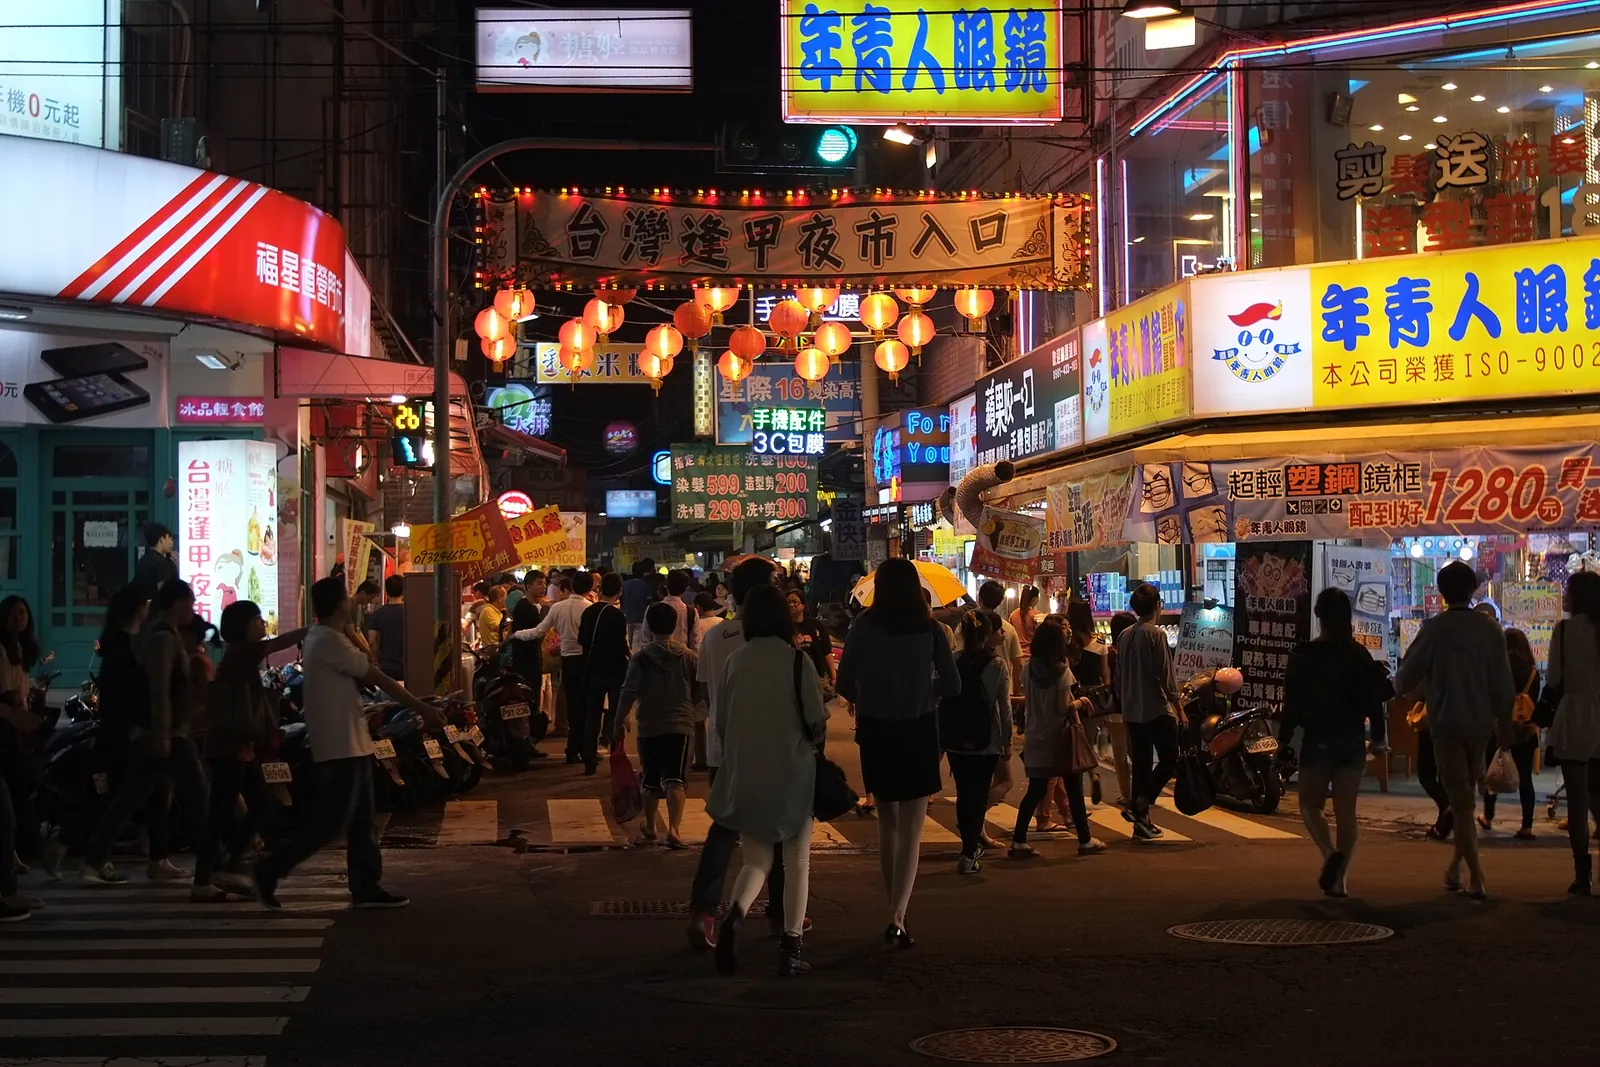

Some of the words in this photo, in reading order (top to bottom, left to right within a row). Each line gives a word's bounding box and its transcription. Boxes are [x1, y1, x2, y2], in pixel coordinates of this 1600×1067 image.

[799, 3, 1047, 94] 年青人眼鏡
[566, 202, 1009, 272] 台灣逢甲夜市入口
[179, 401, 264, 417] 冰品輕食館
[753, 409, 825, 431] 手機配件
[908, 412, 950, 434] For
[754, 432, 825, 454] 3C包膜
[908, 442, 951, 463] You
[1228, 462, 1422, 501] 超輕塑鋼鏡框
[1424, 464, 1545, 524] 1280
[1348, 499, 1423, 528] 配到好
[1250, 520, 1307, 535] 年青人眼鏡
[187, 458, 211, 623] 台灣逢甲夜市
[1247, 596, 1296, 613] 年青人眼鏡
[1249, 620, 1296, 639] 專業驗配
[1177, 653, 1203, 668] 1280
